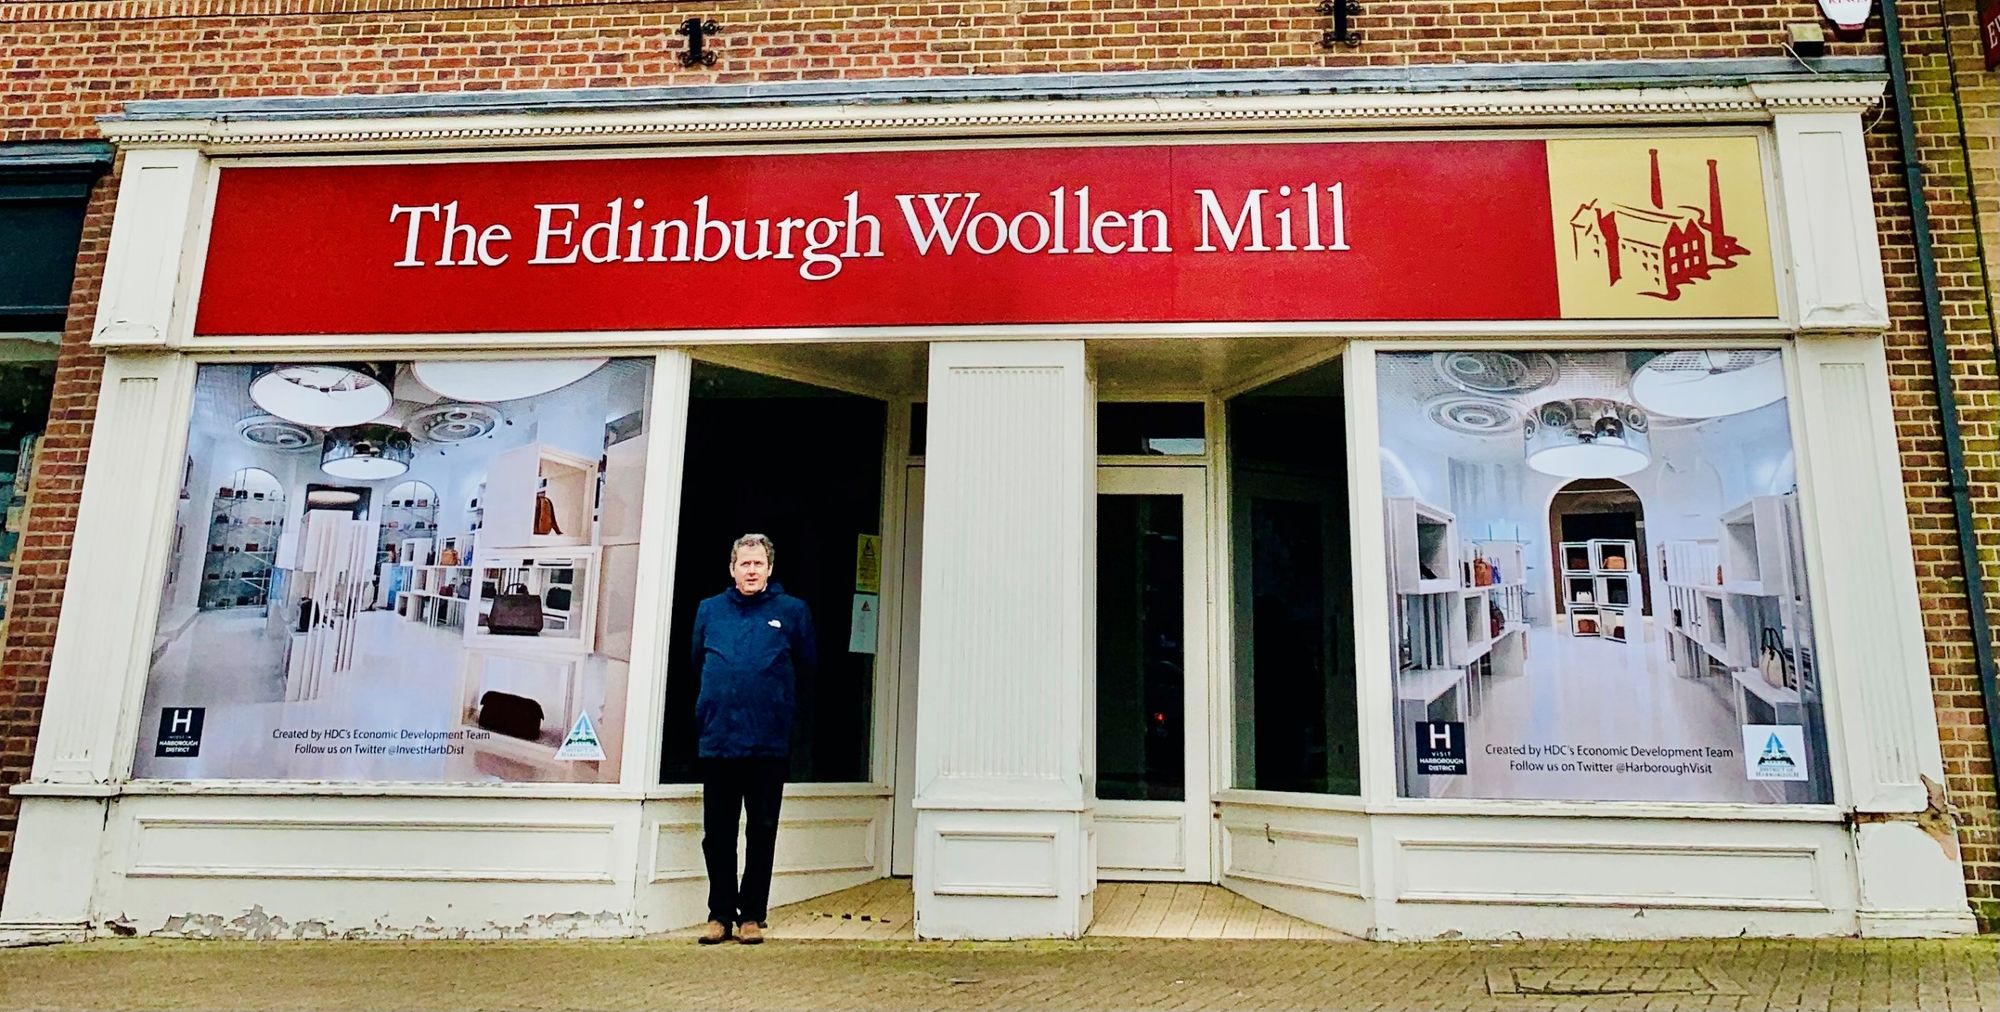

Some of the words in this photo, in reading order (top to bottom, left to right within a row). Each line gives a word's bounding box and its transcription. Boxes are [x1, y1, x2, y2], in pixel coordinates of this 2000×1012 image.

[389, 199, 512, 268] The
[527, 190, 885, 281] Edinburgh
[895, 185, 1173, 257] Woollen
[1193, 181, 1351, 253] Mill
[171, 709, 192, 733] H
[272, 728, 309, 739] Created
[310, 729, 322, 741] by
[324, 729, 351, 740] HDC's
[353, 729, 398, 740] Economic
[400, 729, 464, 741] Development
[466, 729, 491, 740] Team
[1429, 723, 1451, 749] H
[294, 743, 325, 754] Follow
[327, 746, 338, 754] us
[339, 746, 352, 754] on
[354, 744, 386, 754] Twitter
[388, 744, 464, 755] @InvestHarbDist
[1485, 744, 1526, 755] Created
[1528, 744, 1541, 757] by
[1544, 745, 1575, 755] HDC's
[1577, 745, 1628, 756] Economic
[1630, 746, 1703, 758] Development
[1705, 747, 1734, 758] Team
[1510, 760, 1544, 771] Follow
[1547, 763, 1559, 771] us
[1561, 763, 1575, 771] on
[1577, 761, 1613, 772] Twitter
[1616, 762, 1713, 776] @HarboroughVisit
